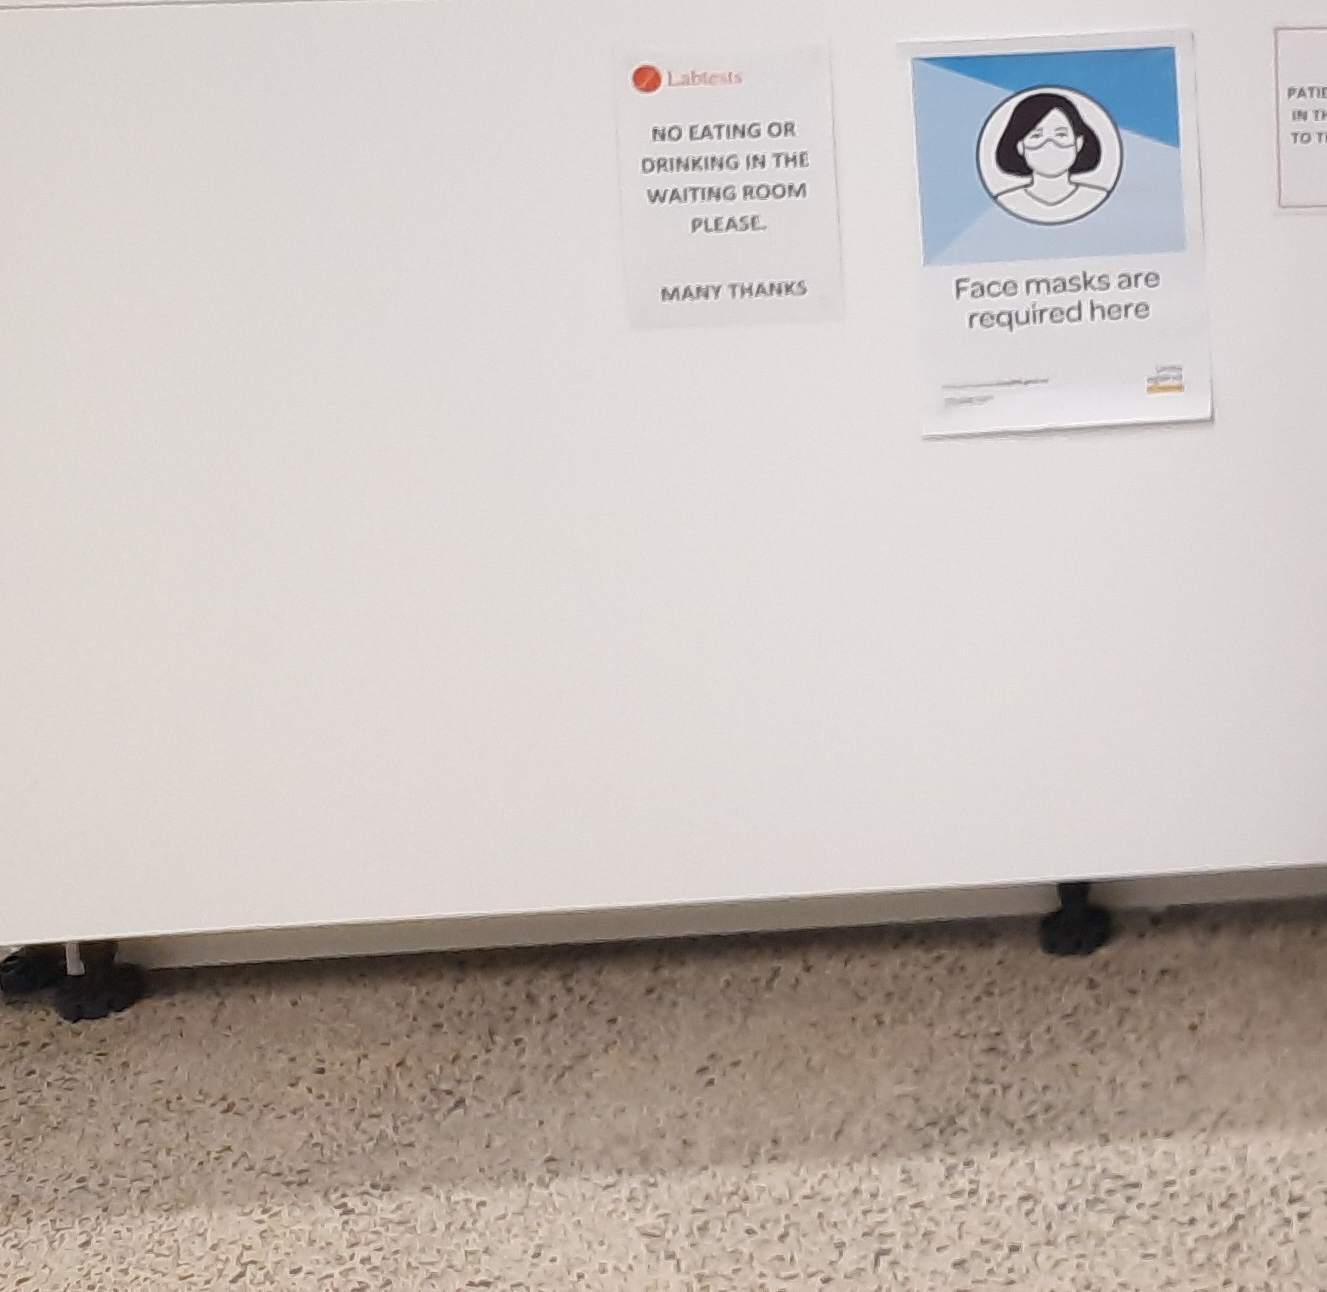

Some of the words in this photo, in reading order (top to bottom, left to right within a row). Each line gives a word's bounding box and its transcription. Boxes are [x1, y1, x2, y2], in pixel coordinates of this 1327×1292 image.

[1291, 109, 1308, 122] IN
[651, 125, 683, 143] NO
[688, 121, 762, 142] EATING
[767, 120, 797, 138] OR
[1291, 131, 1312, 144] TO
[640, 154, 740, 174] DRINKING
[745, 153, 767, 171] IN
[772, 150, 810, 169] THE
[647, 184, 737, 205] WAITING
[742, 182, 808, 202] ROOM
[660, 283, 723, 303] MANY
[727, 279, 808, 300] THANKS
[954, 277, 1018, 301] Face
[1025, 270, 1111, 297] masks
[1117, 270, 1161, 291] are
[968, 299, 1083, 333] required
[1089, 299, 1151, 322] here
